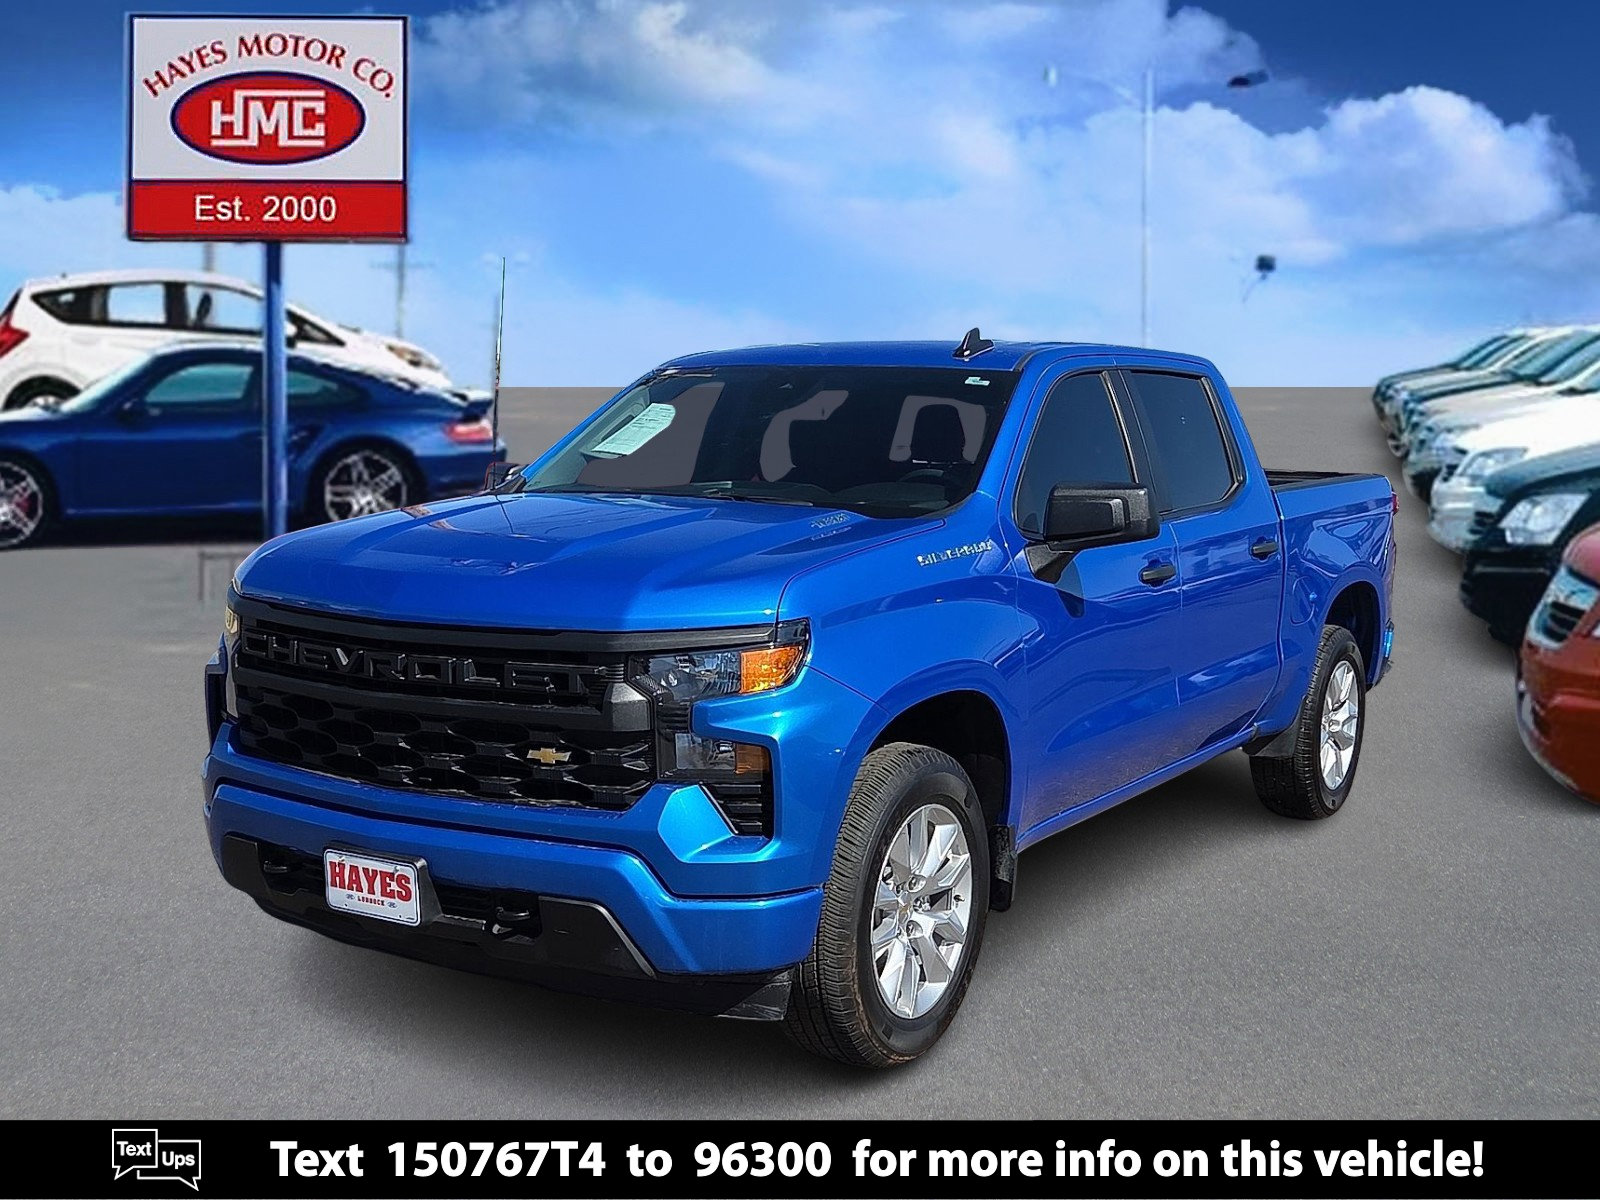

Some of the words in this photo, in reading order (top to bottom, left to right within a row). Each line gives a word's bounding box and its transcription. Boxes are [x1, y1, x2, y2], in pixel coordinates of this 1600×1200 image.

[142, 40, 228, 98] HAYES
[237, 32, 347, 70] MOTOR
[352, 57, 395, 99] CO.
[210, 88, 326, 148] HMC
[195, 194, 250, 222] Est.
[262, 195, 337, 222] 2000
[241, 628, 603, 695] CHEVROLET
[328, 860, 412, 902] HAYES
